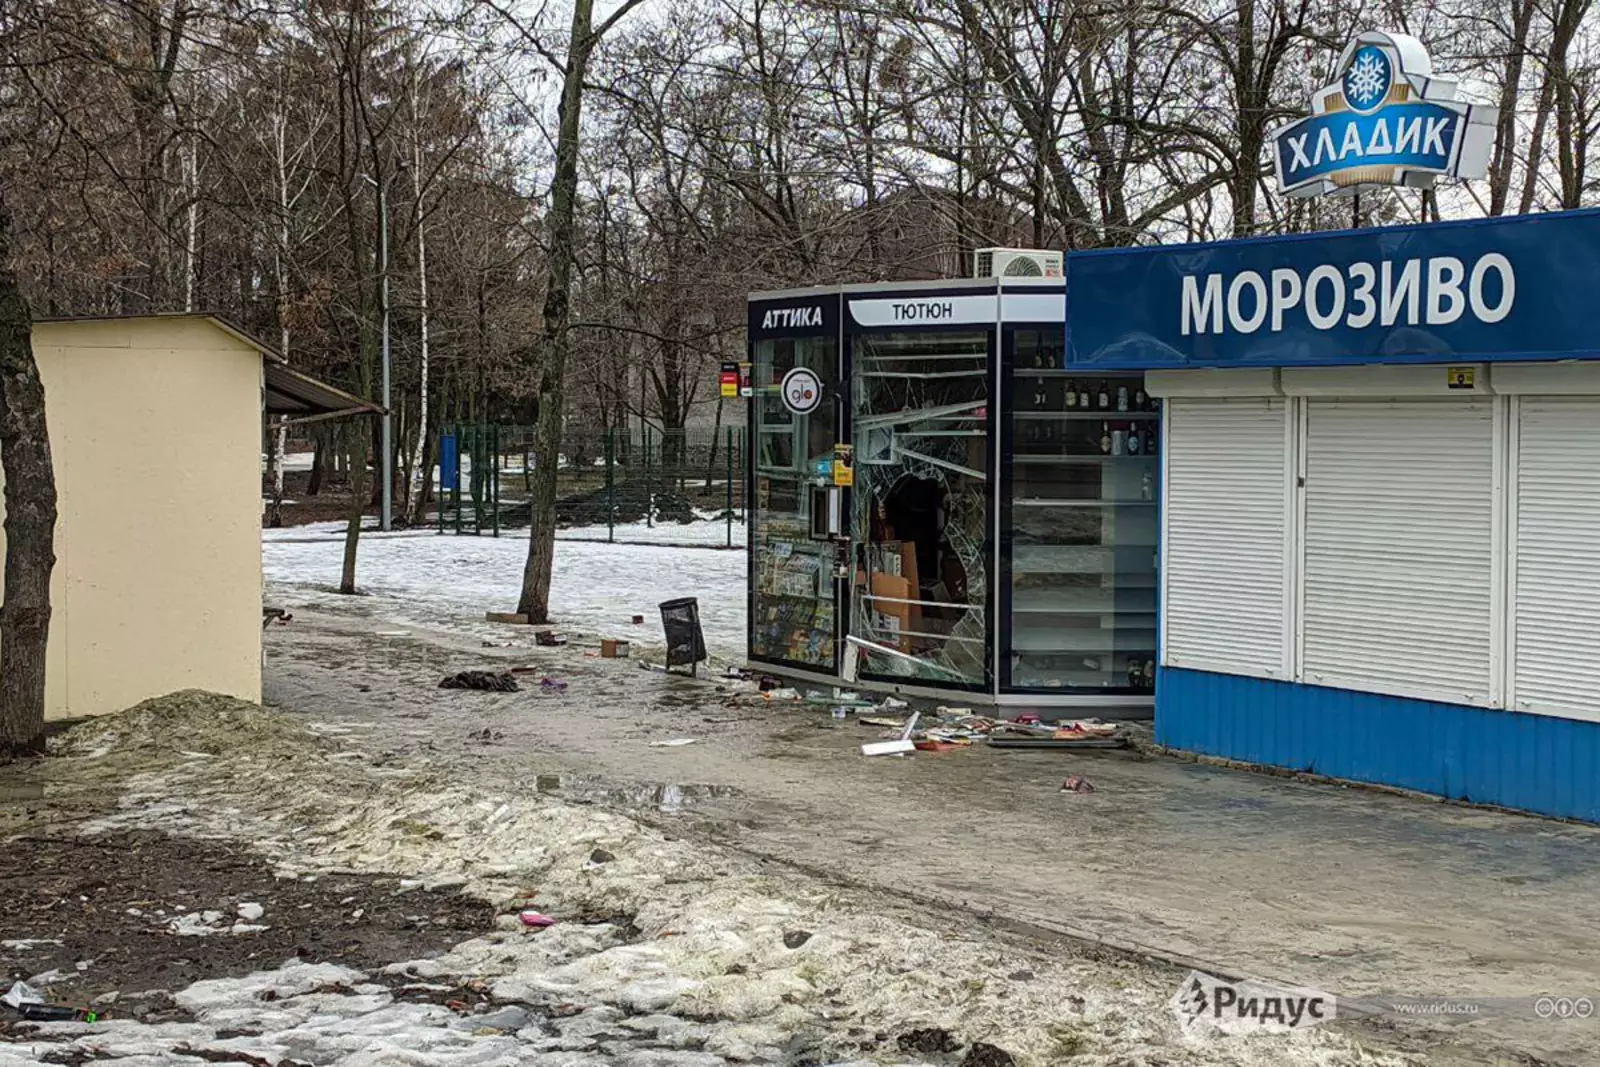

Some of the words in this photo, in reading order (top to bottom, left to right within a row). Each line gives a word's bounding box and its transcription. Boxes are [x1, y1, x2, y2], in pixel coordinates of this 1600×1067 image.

[1288, 116, 1450, 173] ХЛАДИК
[1181, 252, 1517, 336] МОРОЗИВО
[762, 305, 823, 330] АТТИКА
[892, 302, 953, 321] ТЮТЮН
[791, 383, 813, 404] glo
